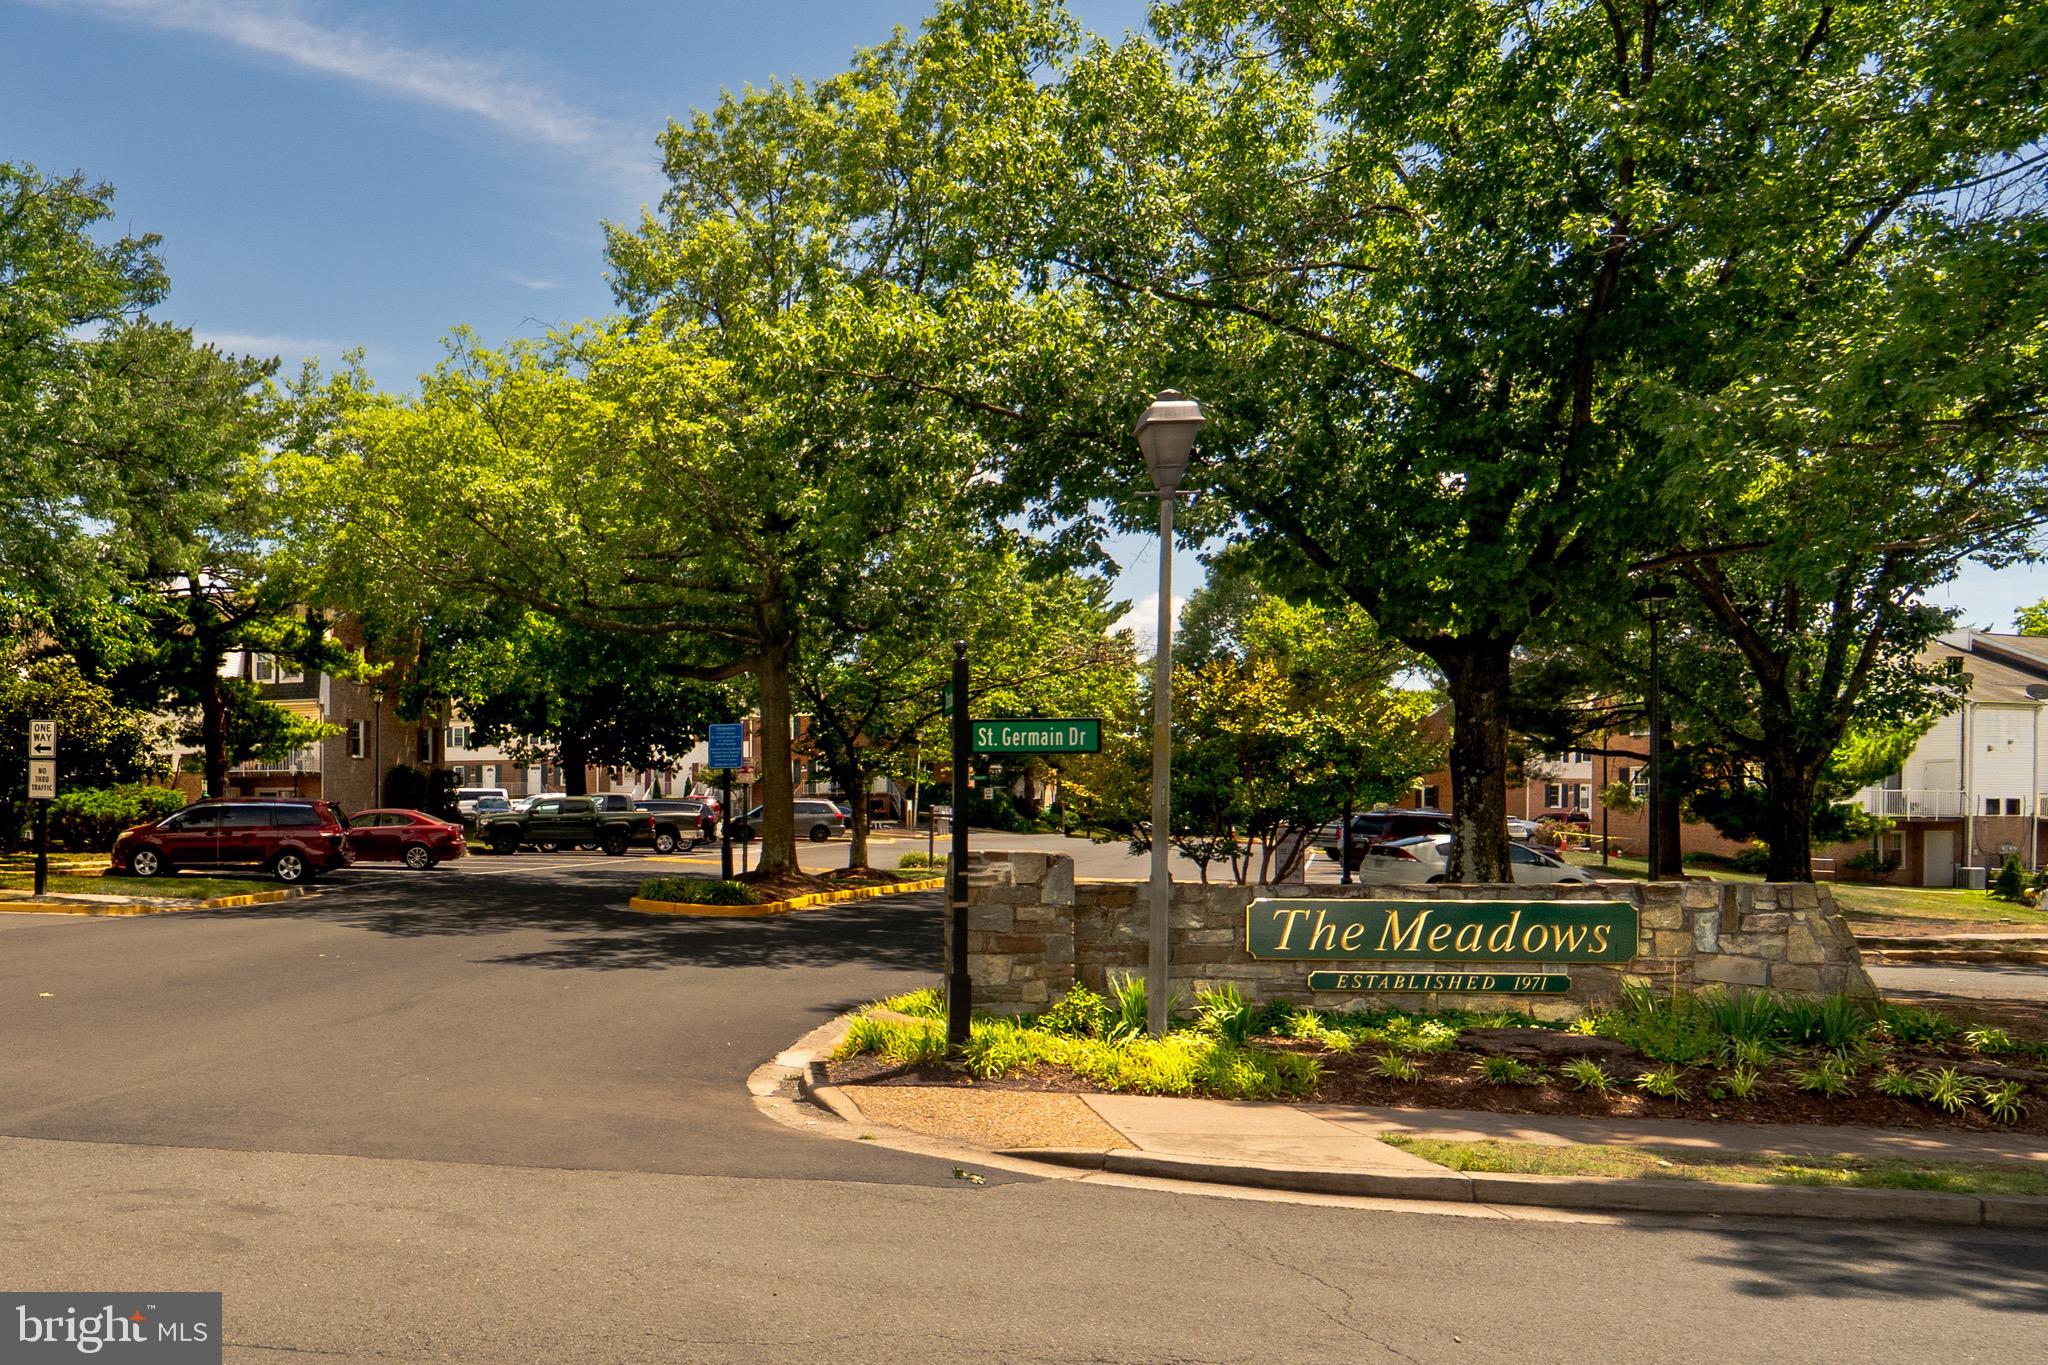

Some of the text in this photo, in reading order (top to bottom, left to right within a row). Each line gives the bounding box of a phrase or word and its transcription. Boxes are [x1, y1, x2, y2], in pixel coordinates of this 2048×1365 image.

[34, 723, 52, 733] ONE
[33, 733, 52, 741] WAY
[978, 727, 1087, 747] St. Germain Dr
[31, 784, 53, 792] TRAFFIC
[1272, 909, 1612, 954] The Meadows
[1336, 975, 1548, 991] ESTABLISHED 1971
